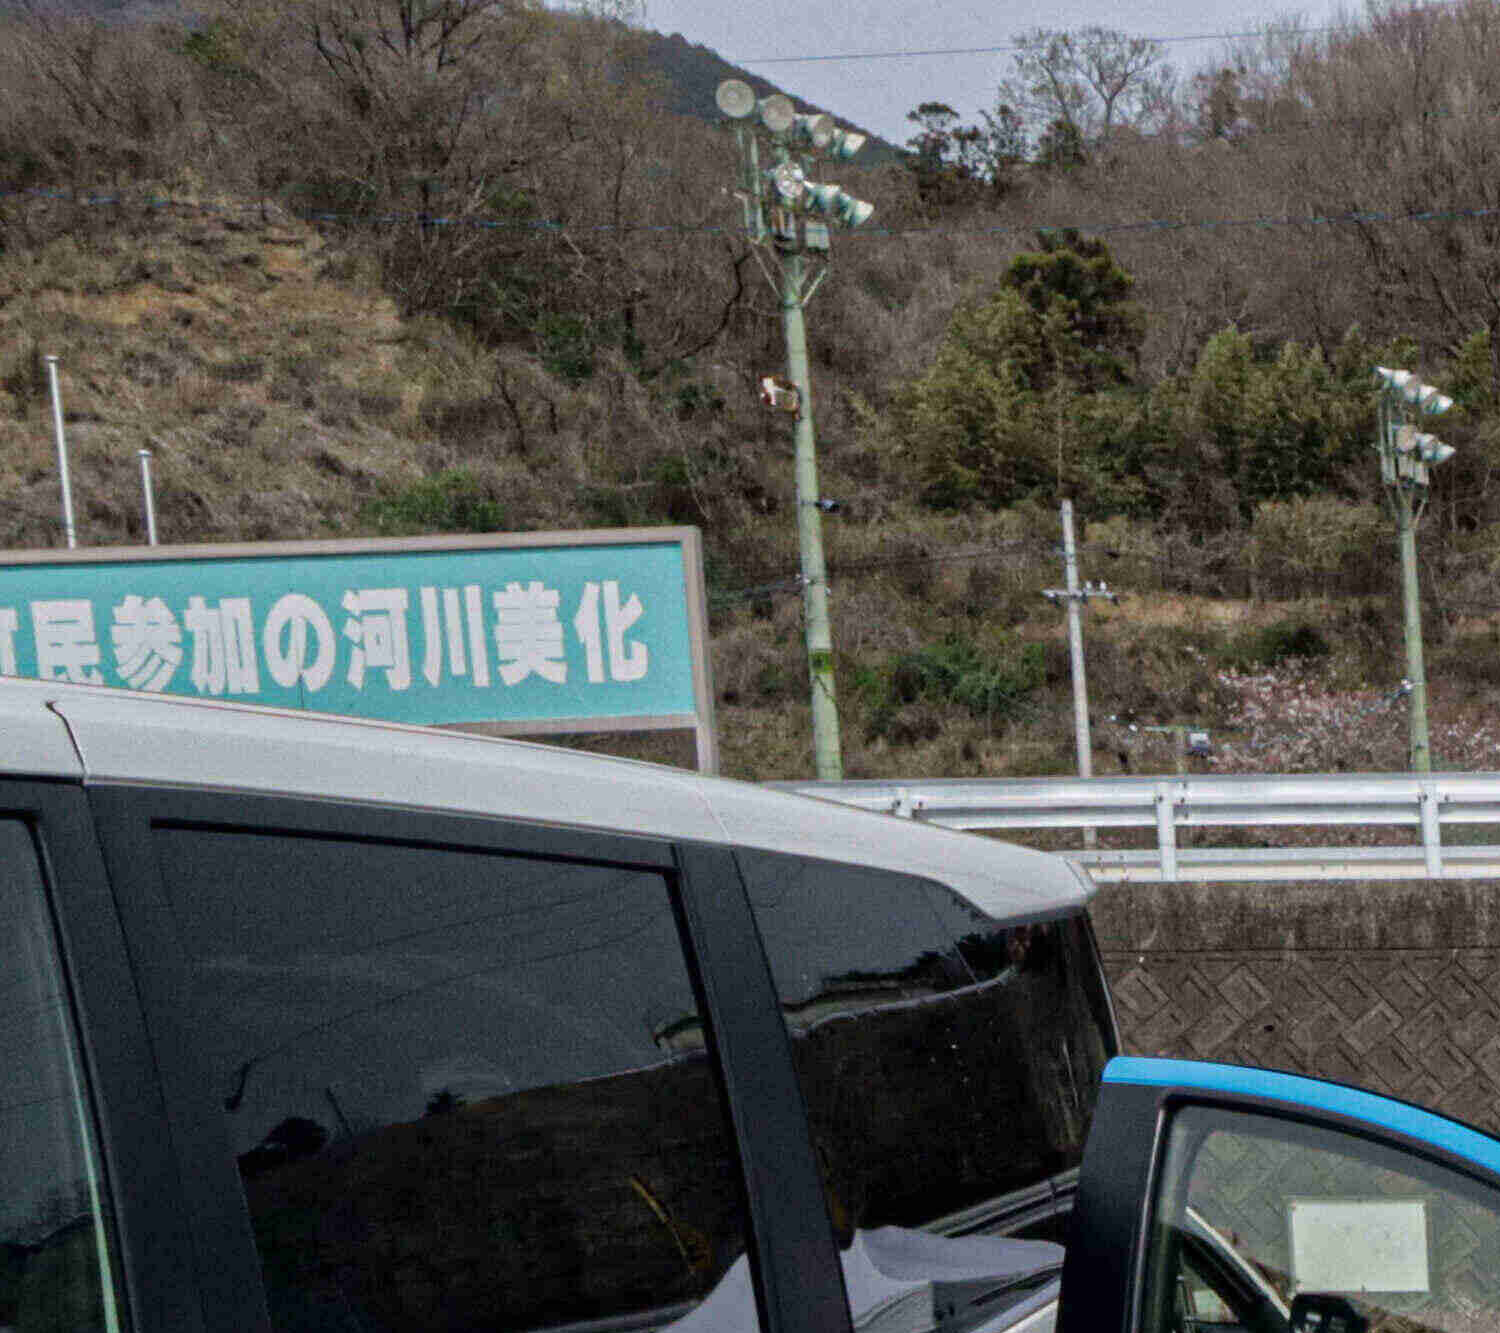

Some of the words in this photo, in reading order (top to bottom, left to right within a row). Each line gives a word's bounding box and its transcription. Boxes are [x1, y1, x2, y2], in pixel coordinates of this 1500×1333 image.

[0, 579, 649, 697] 民参加の河川美化
